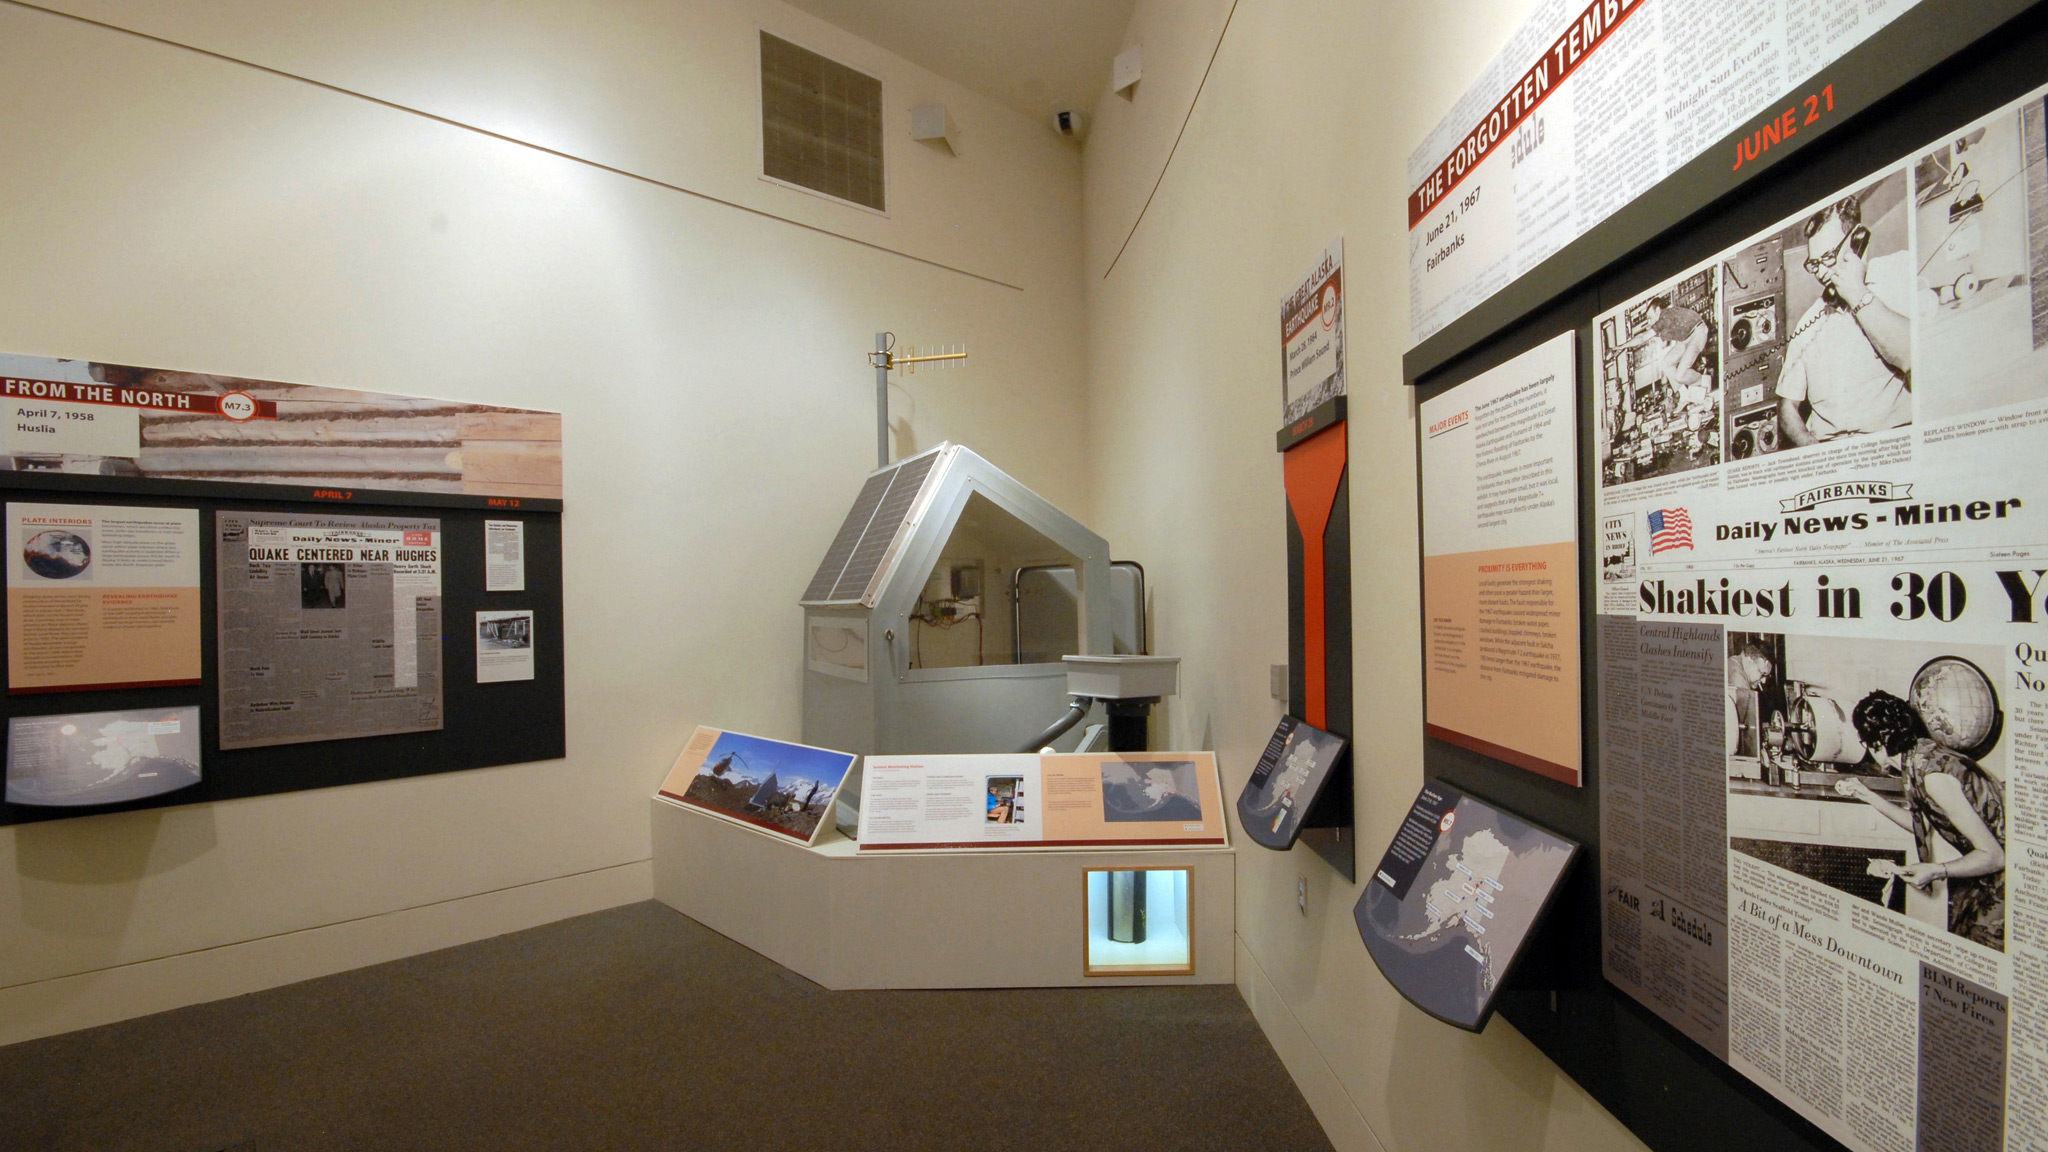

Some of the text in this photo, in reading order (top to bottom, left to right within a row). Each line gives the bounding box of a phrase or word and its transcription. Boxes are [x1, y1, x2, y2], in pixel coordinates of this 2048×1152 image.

[1786, 17, 1804, 36] ping
[1787, 4, 1858, 46] bottles ringing
[1826, 15, 1859, 44] excited
[1665, 40, 1770, 121] Midnight Sun Events
[1418, 169, 1443, 212] THE
[1448, 59, 1549, 186] FORGOTTEN
[1733, 83, 1834, 171] JUNE 21
[1426, 186, 1481, 246] June 21, 1967
[1427, 233, 1465, 272] Fairbanks
[1311, 255, 1333, 289] ALASKA
[1286, 294, 1318, 337] EARTHQUAKE
[1289, 346, 1300, 361] March
[1307, 331, 1318, 346] 1964
[1290, 341, 1330, 379] Prince William Sound
[1529, 381, 1539, 389] been
[1540, 374, 1554, 385] largely
[5, 379, 190, 408] FROM THE NORTH
[17, 408, 94, 421] April 7, 1958
[225, 401, 251, 412] M7.3
[17, 423, 56, 434] Huslia
[1429, 411, 1469, 434] MAJOR EVENTS
[1923, 409, 2041, 436] REPLACES WINDOW Window front
[1956, 430, 1976, 438] broken
[1978, 427, 1993, 435] piece
[2011, 420, 2027, 429] strap
[313, 490, 352, 500] APRIL 7
[488, 498, 520, 507] MAY 12
[1800, 484, 1887, 506] FAIRBANKS
[250, 519, 287, 528] Supreme
[289, 519, 313, 527] Court
[328, 520, 357, 528] Review
[361, 521, 387, 529] Alaska
[387, 522, 420, 530] Property
[1605, 519, 1622, 529] CITY
[1716, 521, 1777, 541] Daily
[1785, 513, 1868, 535] News
[1895, 498, 2021, 526] Miner
[1606, 531, 1627, 541] NEWS
[249, 548, 437, 562] QUAKE CENTERED NEAR HUGHES
[1478, 562, 1547, 573] PROXIMITY IS EVERYTHING
[1639, 577, 1797, 618] Shakiest
[1816, 574, 1861, 619] in
[1891, 571, 1967, 622] 30
[1640, 625, 1720, 643] Central Highlands
[1640, 643, 1714, 664] Clashes Intensify
[2015, 671, 2046, 692] No
[2028, 717, 2044, 725] there
[2015, 739, 2037, 748] Richter
[2015, 755, 2041, 765] between
[1618, 890, 1640, 911] FAIR
[1672, 908, 1712, 946] Schedule
[1738, 899, 1904, 985] A Bit of a Mess Downtown
[1908, 926, 1925, 937] station
[1927, 934, 1953, 947] secretary,
[1956, 945, 1968, 955] wipe
[1979, 955, 1998, 966] excess
[1923, 945, 1955, 965] Department
[1965, 962, 1997, 982] Commerce,
[1932, 942, 1998, 974] located College Hill
[1923, 966, 2006, 1015] BLM Reports
[1978, 976, 1998, 990] (Staff)
[1923, 984, 1995, 1027] 7 New Fires
